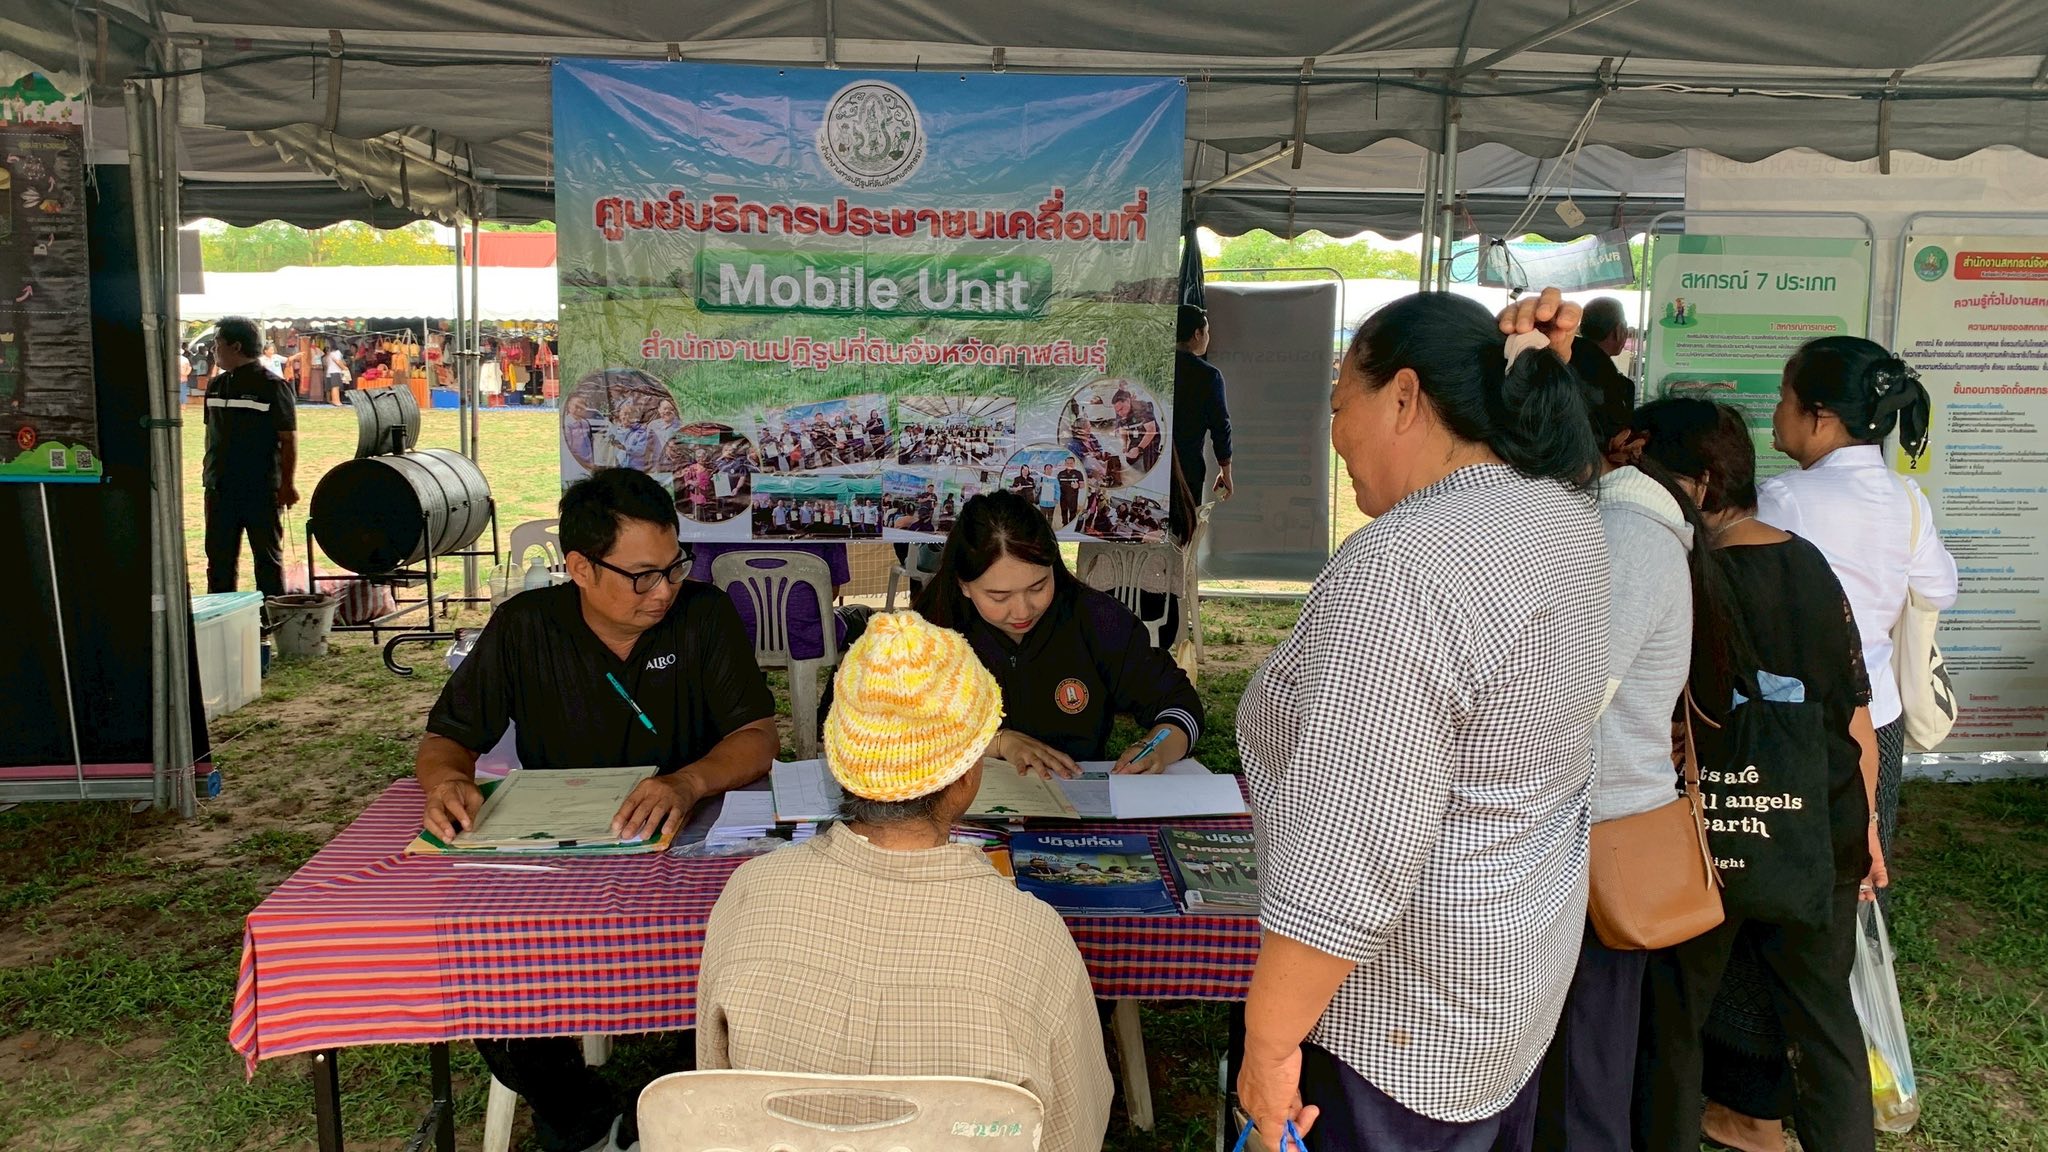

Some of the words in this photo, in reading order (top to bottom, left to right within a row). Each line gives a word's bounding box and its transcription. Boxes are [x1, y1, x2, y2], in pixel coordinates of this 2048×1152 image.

[595, 187, 1148, 242] ศูนย์บริการประชาชนเคลื่อนที่
[718, 263, 901, 311] Mobile
[919, 265, 1030, 313] Unit
[1681, 269, 1749, 292] สหกรณ์
[1756, 272, 1769, 290] 7
[1776, 272, 1837, 292] ประเภท
[640, 328, 1109, 374] สำนักงานปฏิรูปที่ดินจังหวัดกาฬสินธุ์
[1910, 459, 1917, 469] 2
[1724, 765, 1759, 784] are
[1725, 793, 1803, 812] angels
[1703, 816, 1771, 838] earth
[1710, 856, 1746, 870] ight
